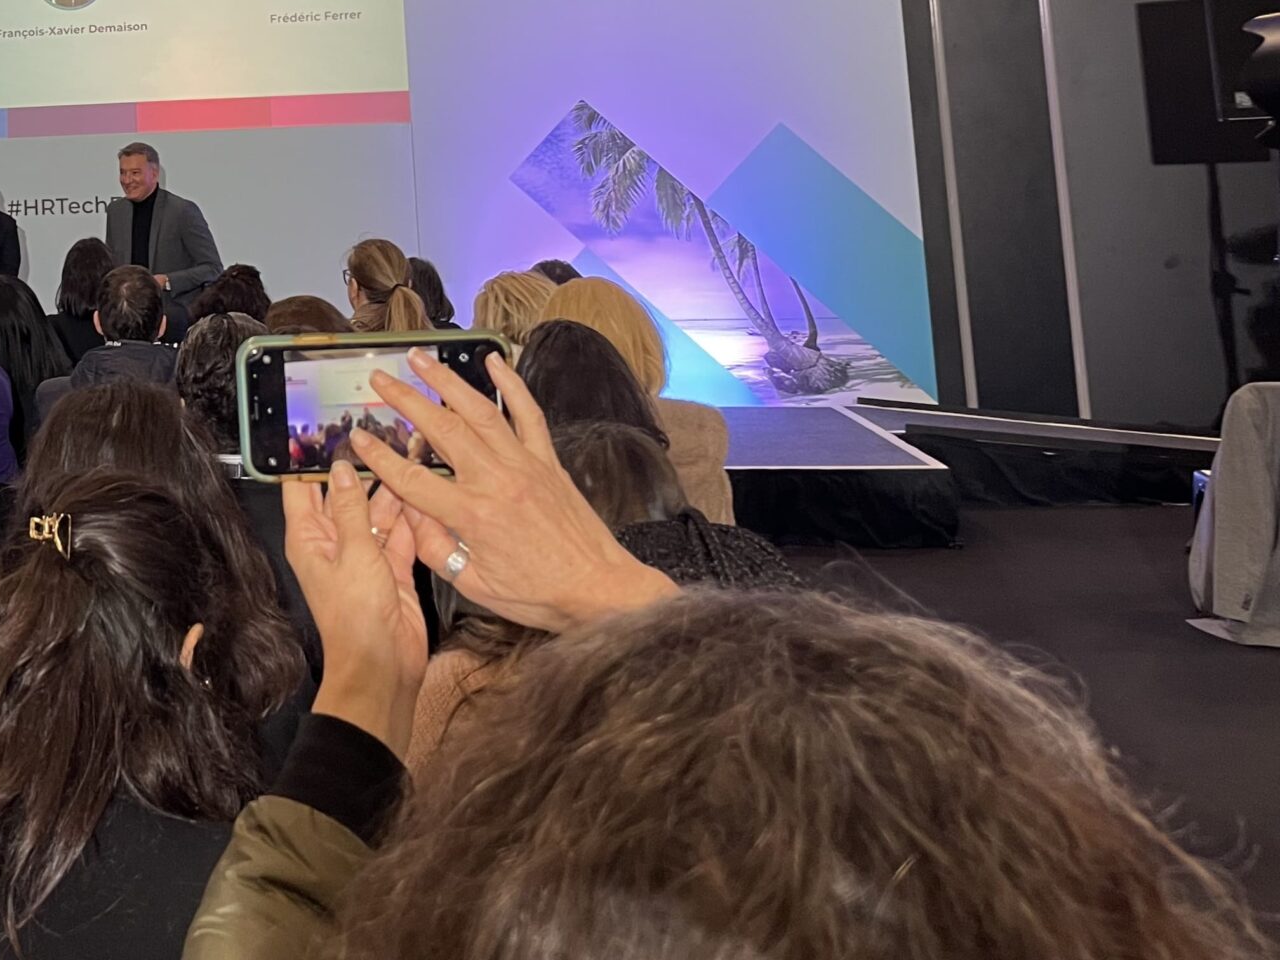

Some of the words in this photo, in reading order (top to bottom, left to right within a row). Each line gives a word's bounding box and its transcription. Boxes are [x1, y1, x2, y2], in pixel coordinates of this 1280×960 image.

[270, 10, 321, 24] Frédéric
[324, 10, 362, 22] Ferrer
[88, 21, 148, 35] Demaison
[7, 196, 123, 217] #HRTech
